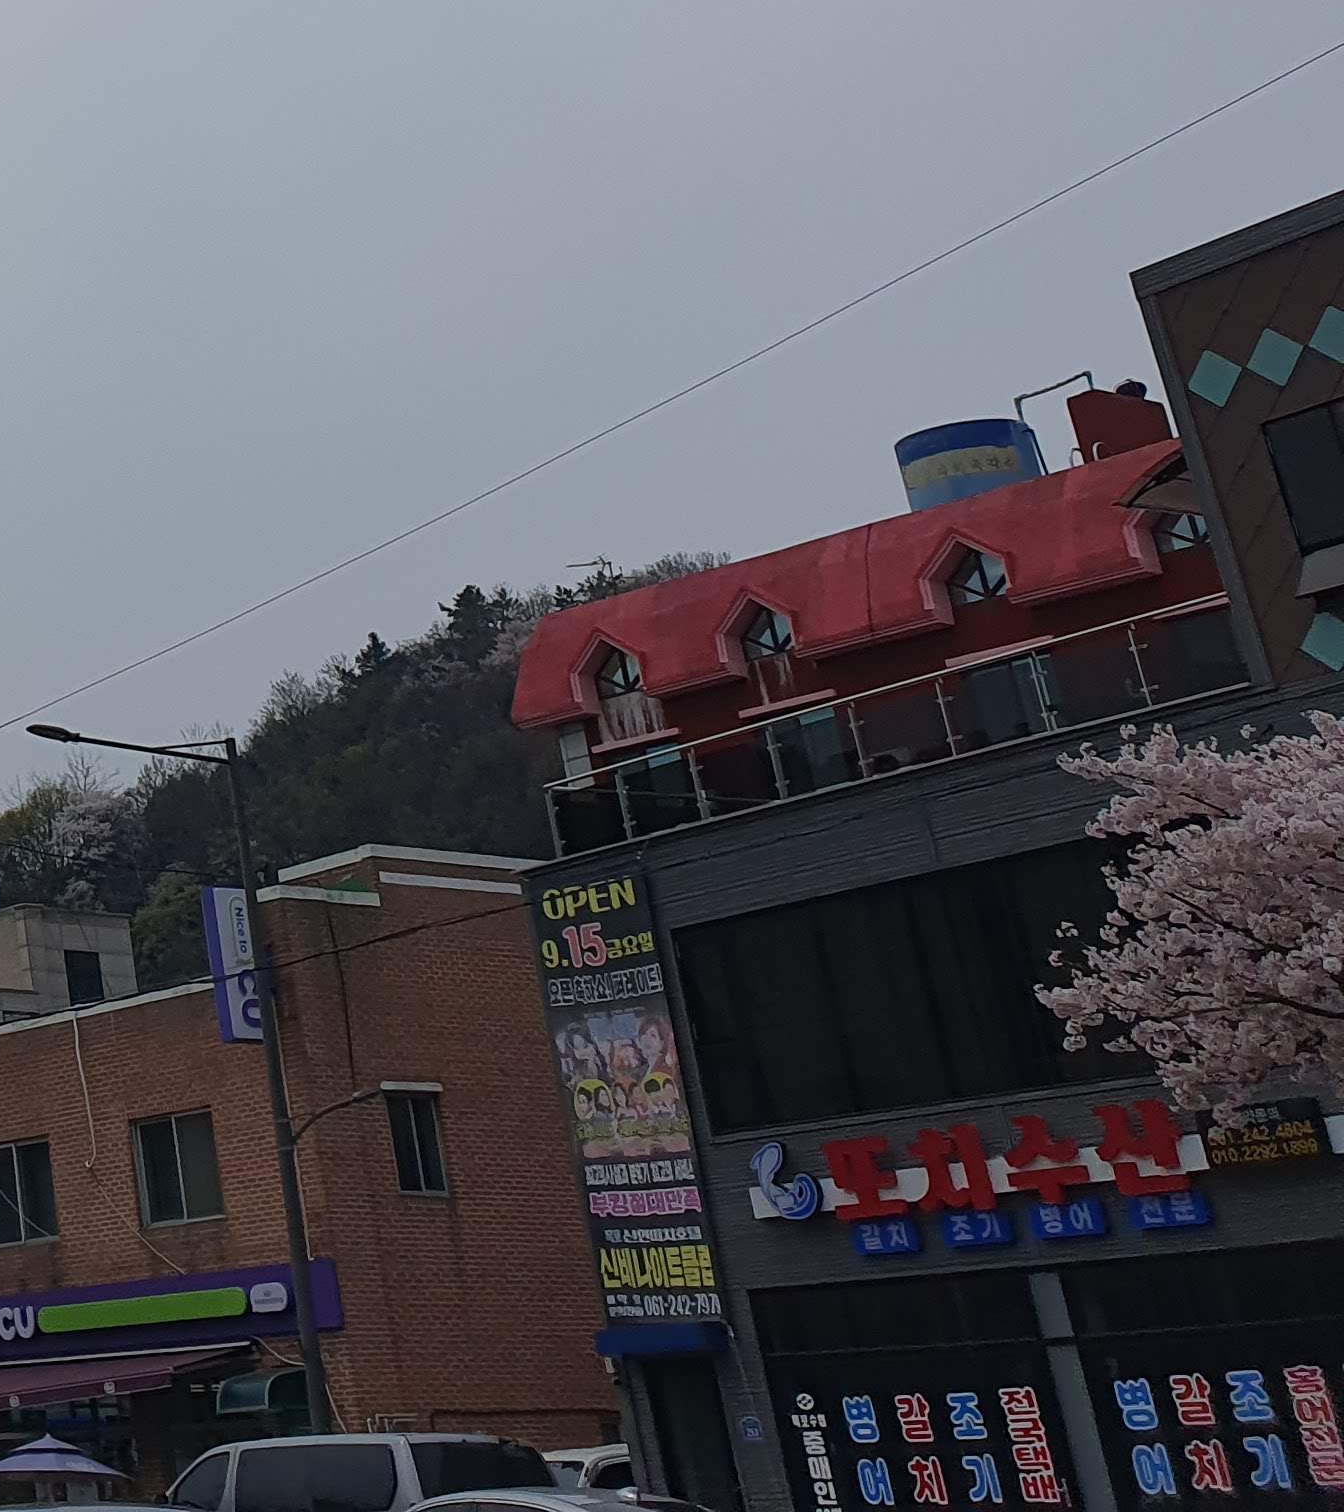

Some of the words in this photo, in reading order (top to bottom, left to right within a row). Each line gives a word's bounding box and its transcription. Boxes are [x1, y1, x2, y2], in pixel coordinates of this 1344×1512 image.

[542, 875, 636, 920] OPEN
[820, 1098, 1188, 1224] 또치수산
[859, 1222, 910, 1251] 갈치
[951, 1216, 1002, 1242] 조기
[894, 1392, 949, 1505] 갈치
[946, 1392, 1003, 1504] 조기
[998, 1386, 1061, 1503] 전국택배
[1169, 1372, 1233, 1492] 갈치
[1225, 1369, 1292, 1489] 조기
